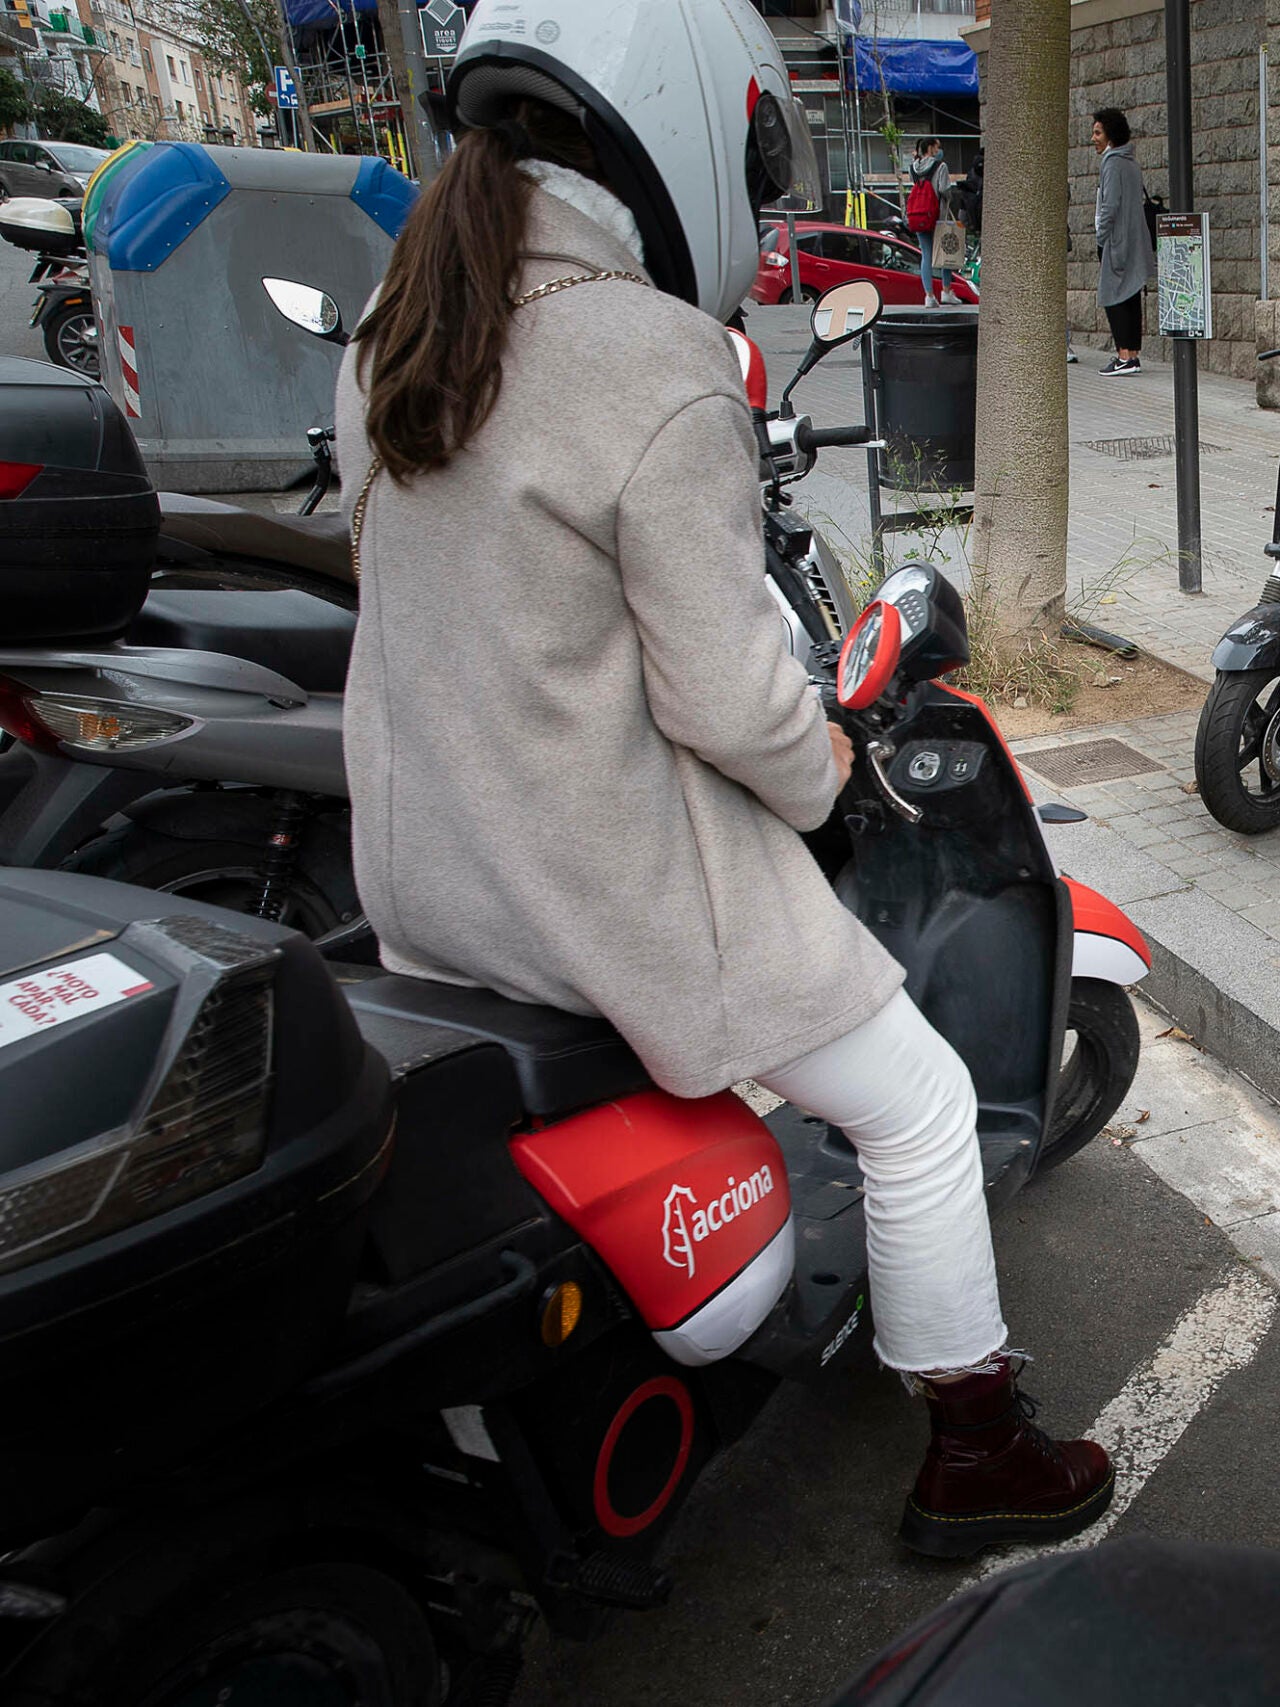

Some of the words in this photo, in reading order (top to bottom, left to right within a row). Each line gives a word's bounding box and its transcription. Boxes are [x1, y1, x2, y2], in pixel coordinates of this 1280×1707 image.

[434, 29, 455, 37] area
[279, 69, 293, 92] P
[16, 981, 56, 1009] APAR-
[46, 971, 99, 999] ¿MOTO
[48, 985, 80, 1006] MAL
[8, 994, 58, 1026] CADA?
[691, 1164, 774, 1242] acciona
